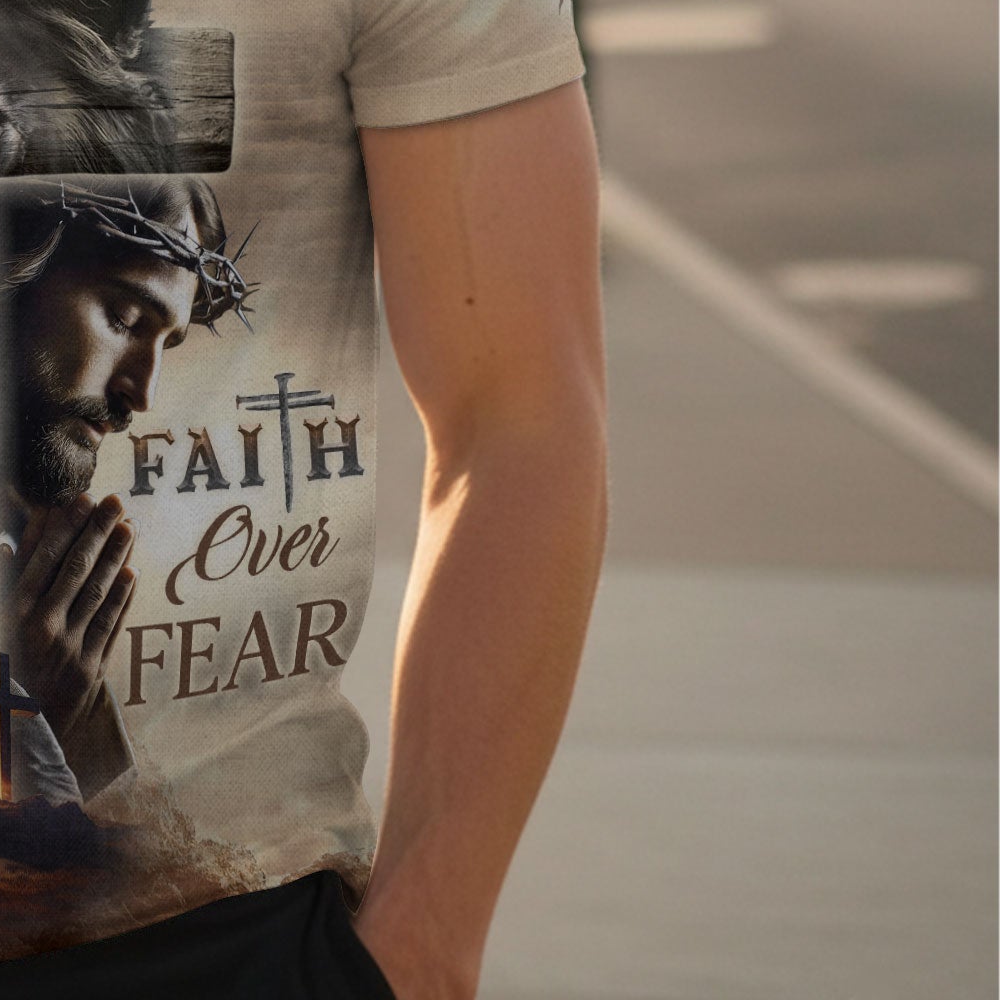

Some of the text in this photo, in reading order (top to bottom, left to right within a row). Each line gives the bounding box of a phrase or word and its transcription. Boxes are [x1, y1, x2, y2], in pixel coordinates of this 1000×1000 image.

[128, 373, 365, 513] FAITH
[165, 504, 340, 605] Over
[124, 599, 347, 706] FEAR
